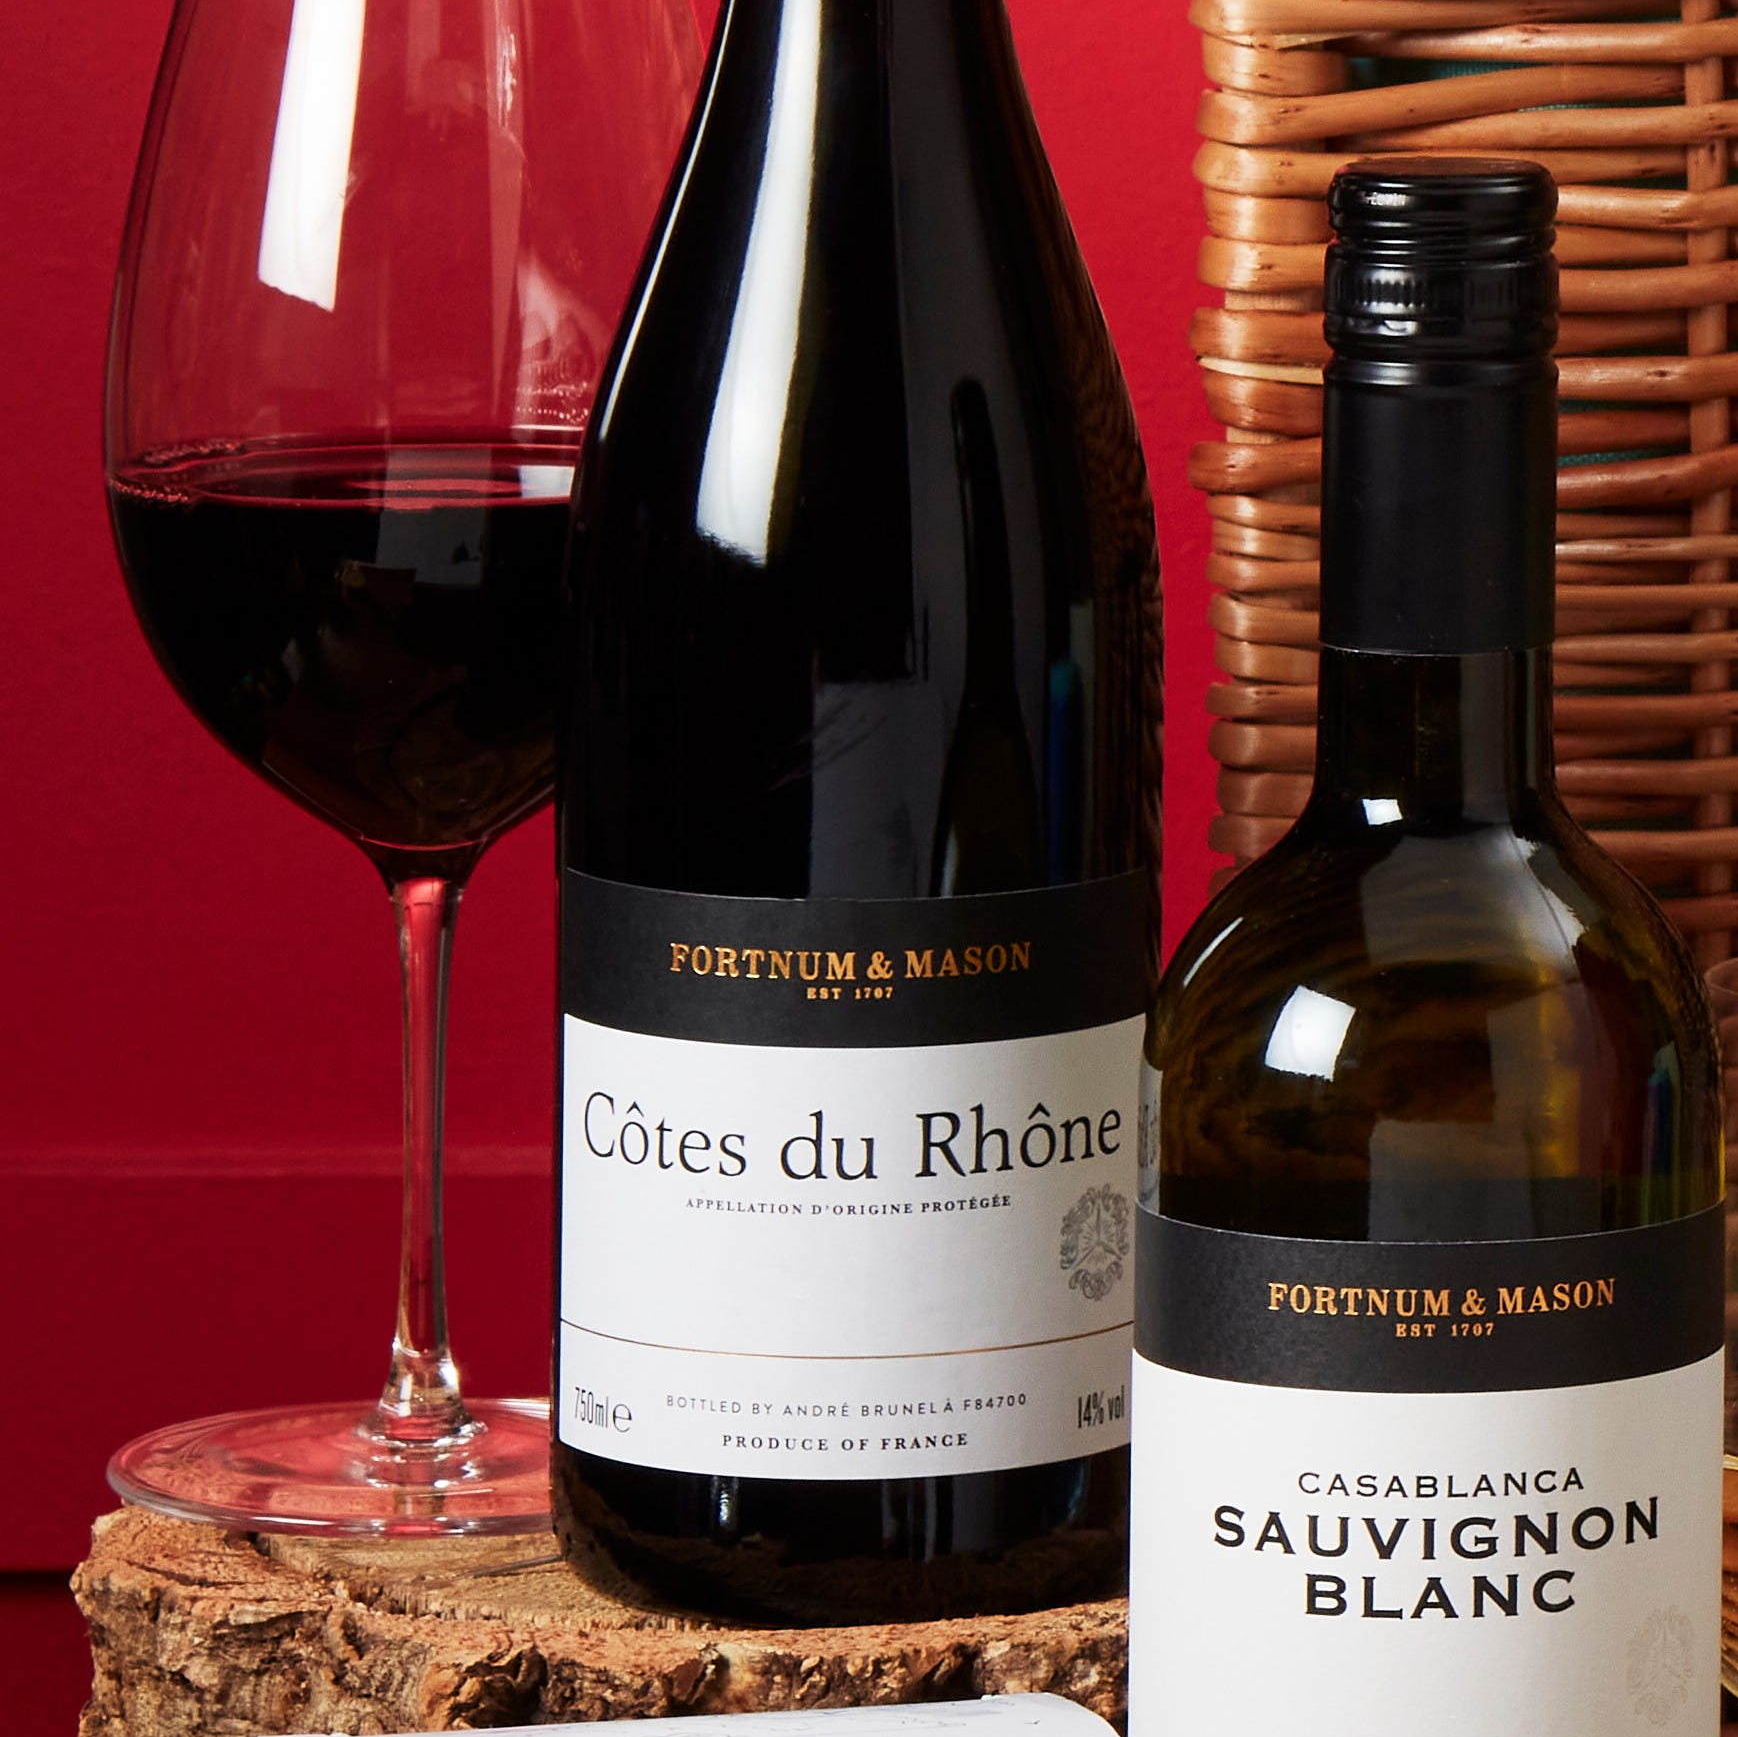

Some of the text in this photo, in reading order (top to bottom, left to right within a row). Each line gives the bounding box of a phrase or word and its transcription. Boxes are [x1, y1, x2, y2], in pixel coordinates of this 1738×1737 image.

[670, 942, 1032, 980] FORTNUM & MASON
[807, 987, 894, 1000] EST 1707
[584, 1092, 747, 1177] Côtes
[779, 1110, 877, 1181] du
[915, 1102, 1122, 1178] Rhône
[686, 1197, 802, 1214] APPELLATION
[921, 1194, 1011, 1213] PROTÉGÉE
[1268, 1278, 1616, 1317] FORTNUM & MASON
[1395, 1323, 1495, 1337] EST 1707
[667, 1395, 741, 1415] BOTTLED
[751, 1402, 773, 1416] BY
[784, 1401, 850, 1417] ANDRÉ
[964, 1392, 1027, 1411] F84700
[722, 1433, 968, 1452] PRODUCE OF FRANCE
[1298, 1467, 1584, 1498] CASABLANCA
[1214, 1497, 1660, 1560] SAUVIGNON
[1305, 1571, 1576, 1619] BLANC
